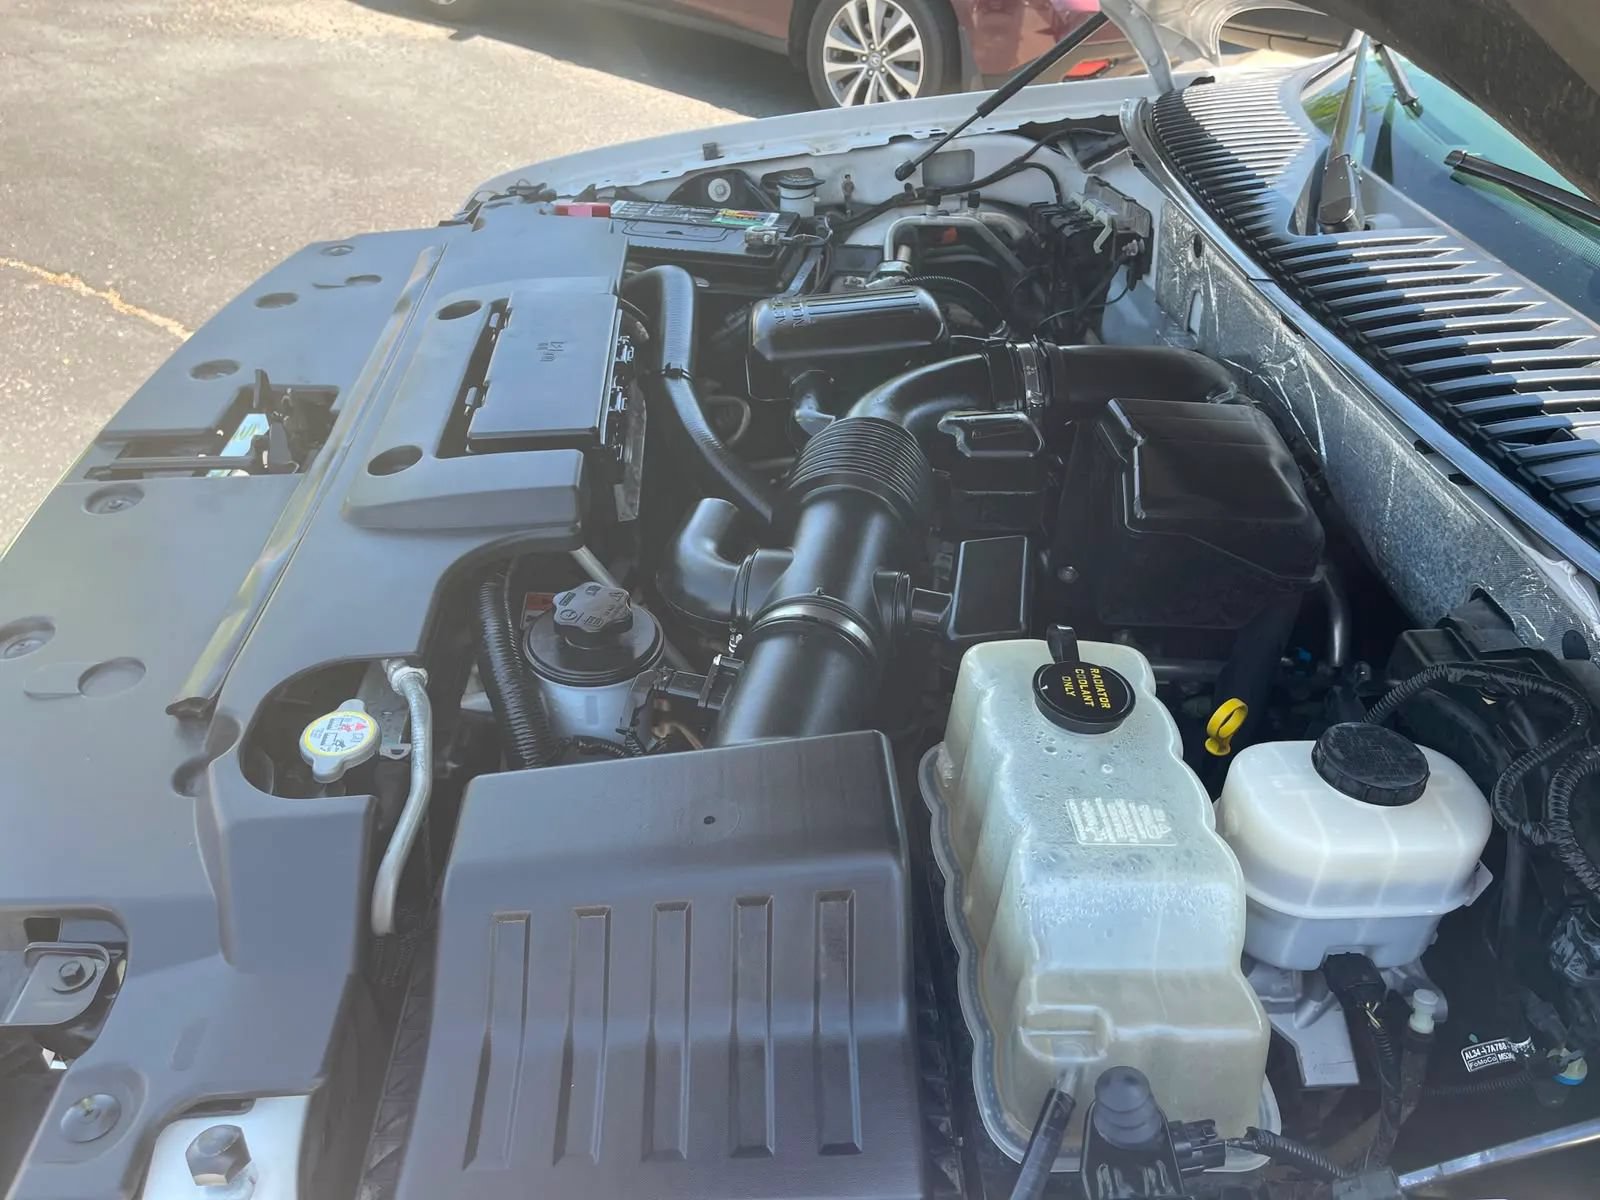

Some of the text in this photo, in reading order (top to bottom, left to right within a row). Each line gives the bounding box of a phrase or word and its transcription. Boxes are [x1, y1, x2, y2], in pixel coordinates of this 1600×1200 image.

[1062, 675, 1076, 697] ONLY
[1075, 668, 1095, 708] COOLANT
[1090, 667, 1111, 709] RADIATOR
[1468, 1056, 1498, 1069] FoMoCo
